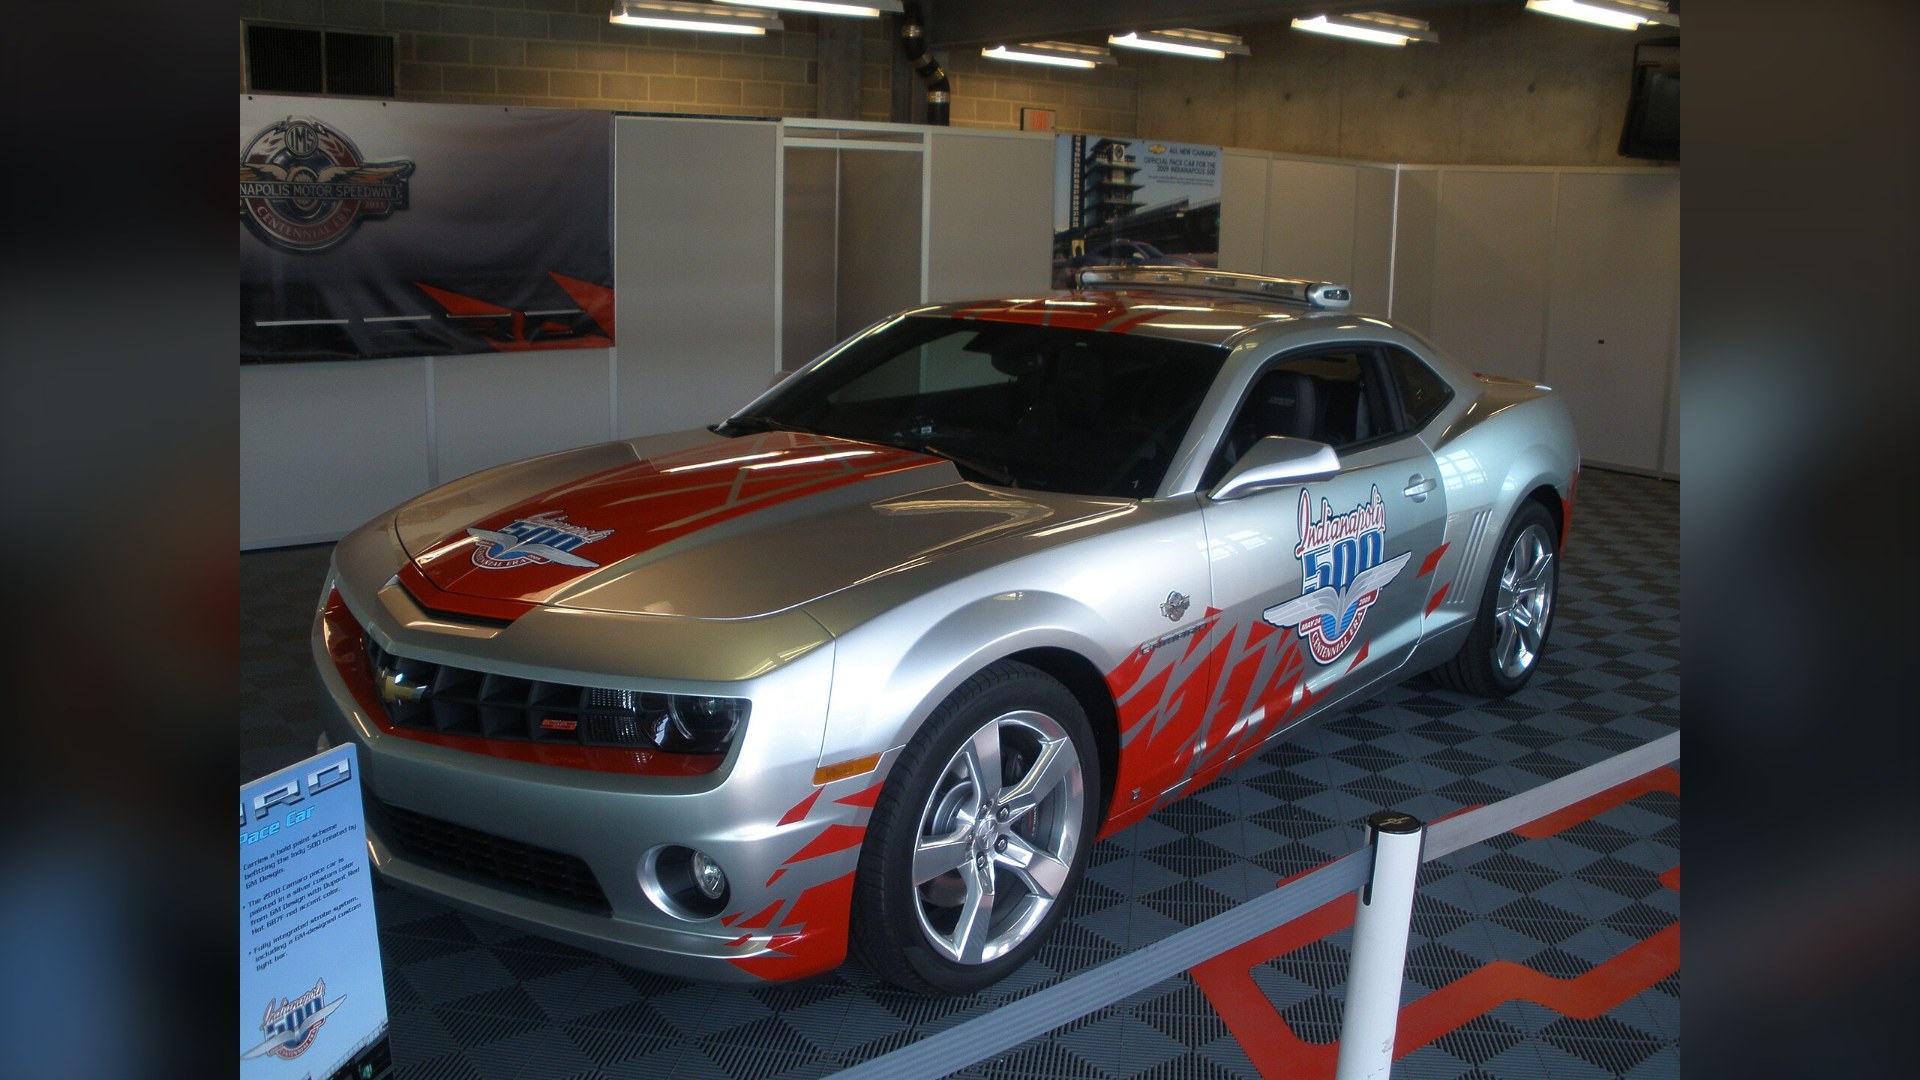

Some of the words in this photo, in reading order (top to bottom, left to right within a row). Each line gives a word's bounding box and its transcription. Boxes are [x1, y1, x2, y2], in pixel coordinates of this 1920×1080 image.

[288, 125, 315, 151] IMS
[293, 184, 333, 197] MOTOR
[335, 185, 394, 198] SPEEDWAY
[257, 205, 333, 238] CENTENNIAL
[1295, 483, 1386, 558] Indianapolis
[1302, 528, 1385, 595] 500
[1311, 631, 1348, 658] CENTENNIAL
[1349, 612, 1363, 636] ERA
[286, 806, 315, 827] Car
[243, 856, 269, 870] Carries
[276, 844, 292, 856] bold
[293, 836, 310, 849] paint
[312, 823, 337, 841] scheme
[244, 859, 276, 880] befitting
[277, 855, 289, 865] the
[291, 848, 306, 859] Indy
[307, 840, 321, 851] 500
[322, 828, 347, 844] created
[348, 823, 357, 833] by
[245, 880, 258, 889] GM
[249, 900, 277, 917] painted
[292, 883, 311, 896] silver
[312, 871, 337, 886] custom
[339, 861, 354, 873] color
[250, 915, 268, 926] from
[269, 907, 282, 916] GM
[283, 895, 306, 914] Design
[307, 887, 322, 898] with
[348, 866, 360, 877] Red
[263, 888, 281, 900] 2010
[282, 876, 308, 892] Camaro
[309, 867, 325, 879] pace
[326, 862, 336, 870] car
[251, 926, 265, 936] Hot
[286, 908, 298, 919] red
[299, 897, 321, 911] accent
[322, 888, 341, 900] color.
[254, 941, 272, 953] Fully
[272, 919, 309, 944] integrated
[310, 909, 332, 923] strobe
[333, 896, 359, 912] system.
[255, 941, 287, 962] including
[338, 903, 362, 918] custom
[256, 960, 273, 972] light
[274, 952, 288, 962] bar.
